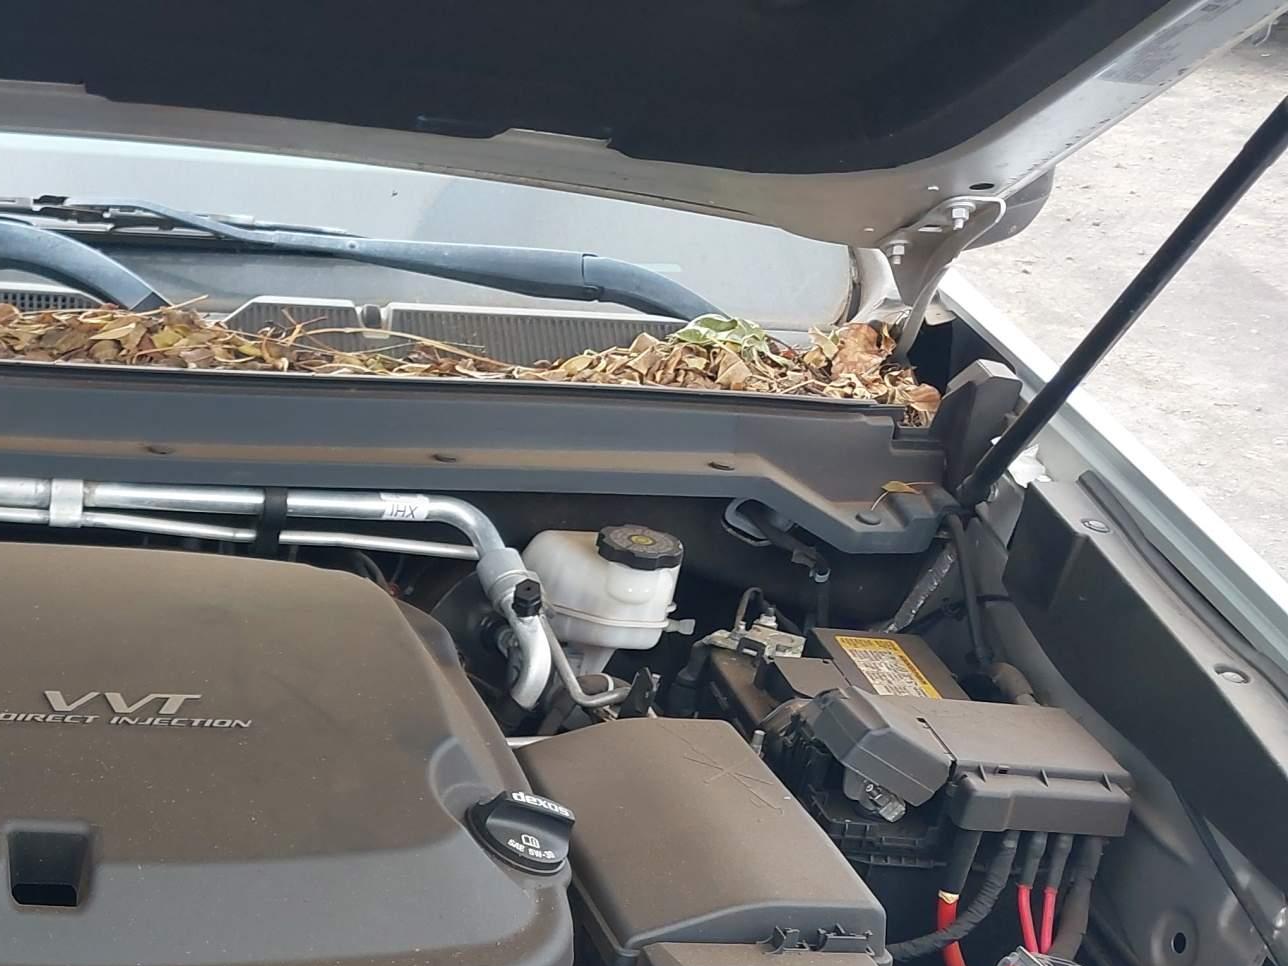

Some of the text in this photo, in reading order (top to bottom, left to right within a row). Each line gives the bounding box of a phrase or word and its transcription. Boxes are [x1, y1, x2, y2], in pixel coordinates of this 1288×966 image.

[44, 690, 202, 715] VVT
[110, 715, 253, 729] INJECTION
[512, 791, 570, 817] dexos
[507, 838, 525, 853] SAE
